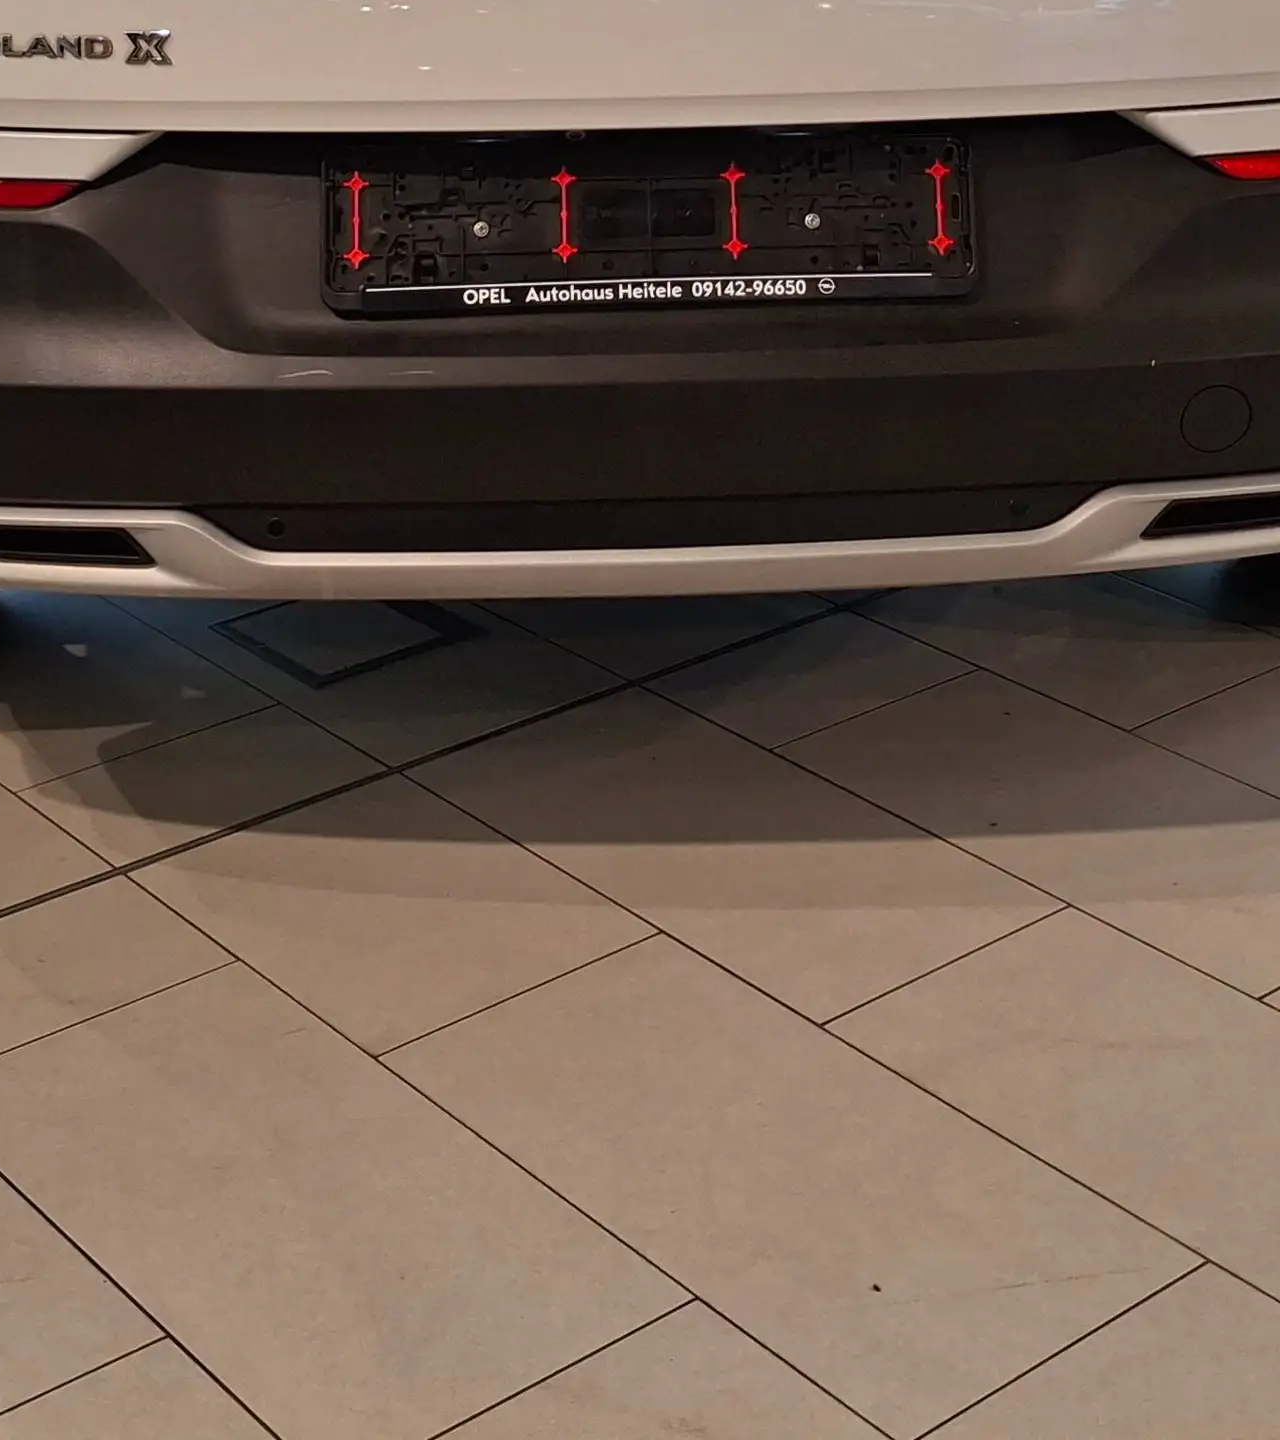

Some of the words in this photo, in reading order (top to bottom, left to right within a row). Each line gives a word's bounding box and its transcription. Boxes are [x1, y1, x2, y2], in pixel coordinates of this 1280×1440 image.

[122, 29, 174, 66] X
[462, 287, 511, 305] OPEL
[524, 284, 614, 303] Autohaus
[618, 281, 683, 300] Heitele
[691, 279, 807, 298] 09142-96650
